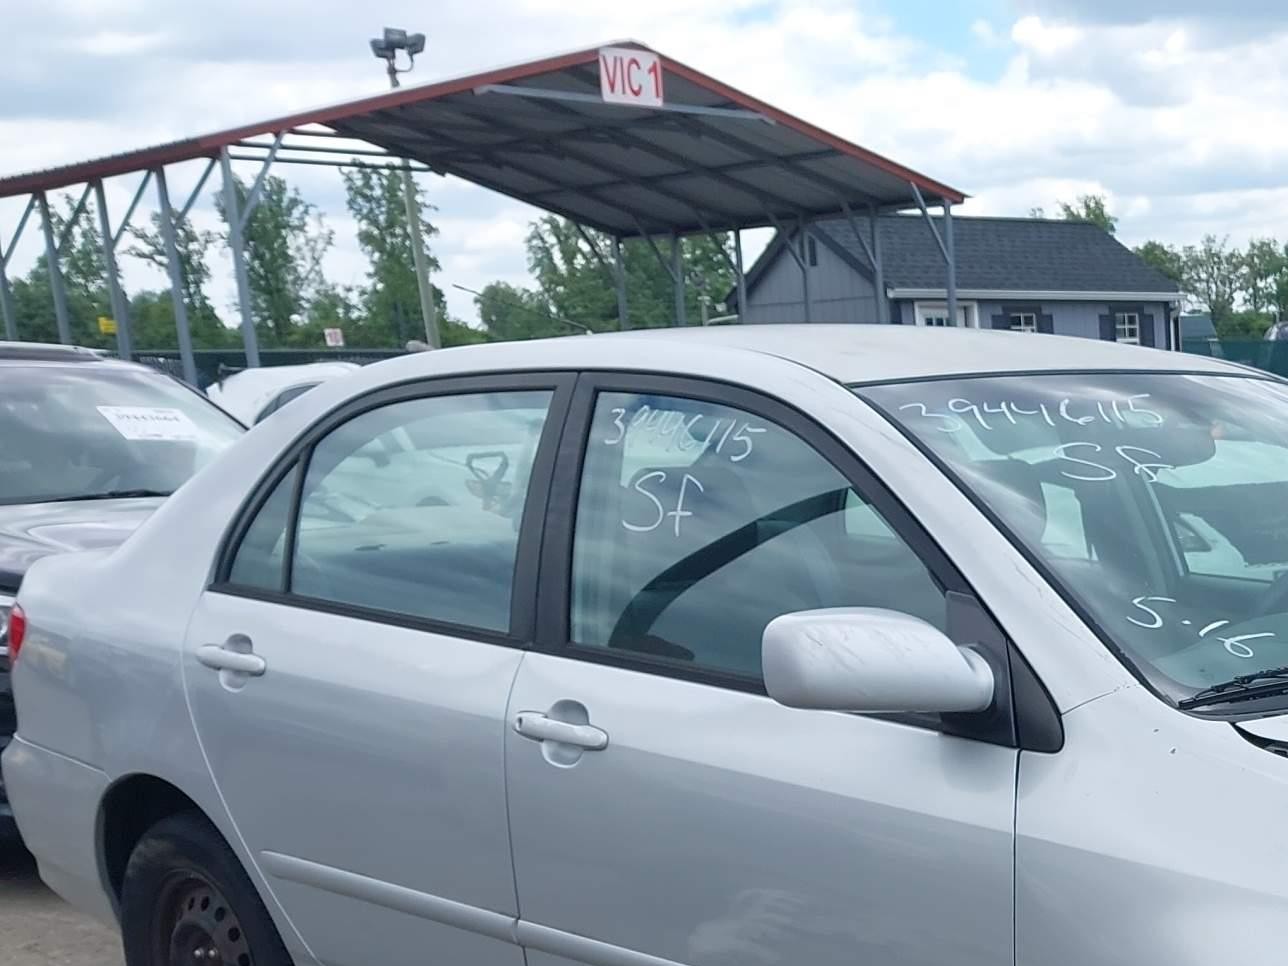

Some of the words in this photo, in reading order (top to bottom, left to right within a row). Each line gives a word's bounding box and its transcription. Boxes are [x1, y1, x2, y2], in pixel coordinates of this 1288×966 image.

[602, 55, 642, 97] VIC
[648, 61, 660, 98] 1
[899, 394, 1163, 432] 39446115
